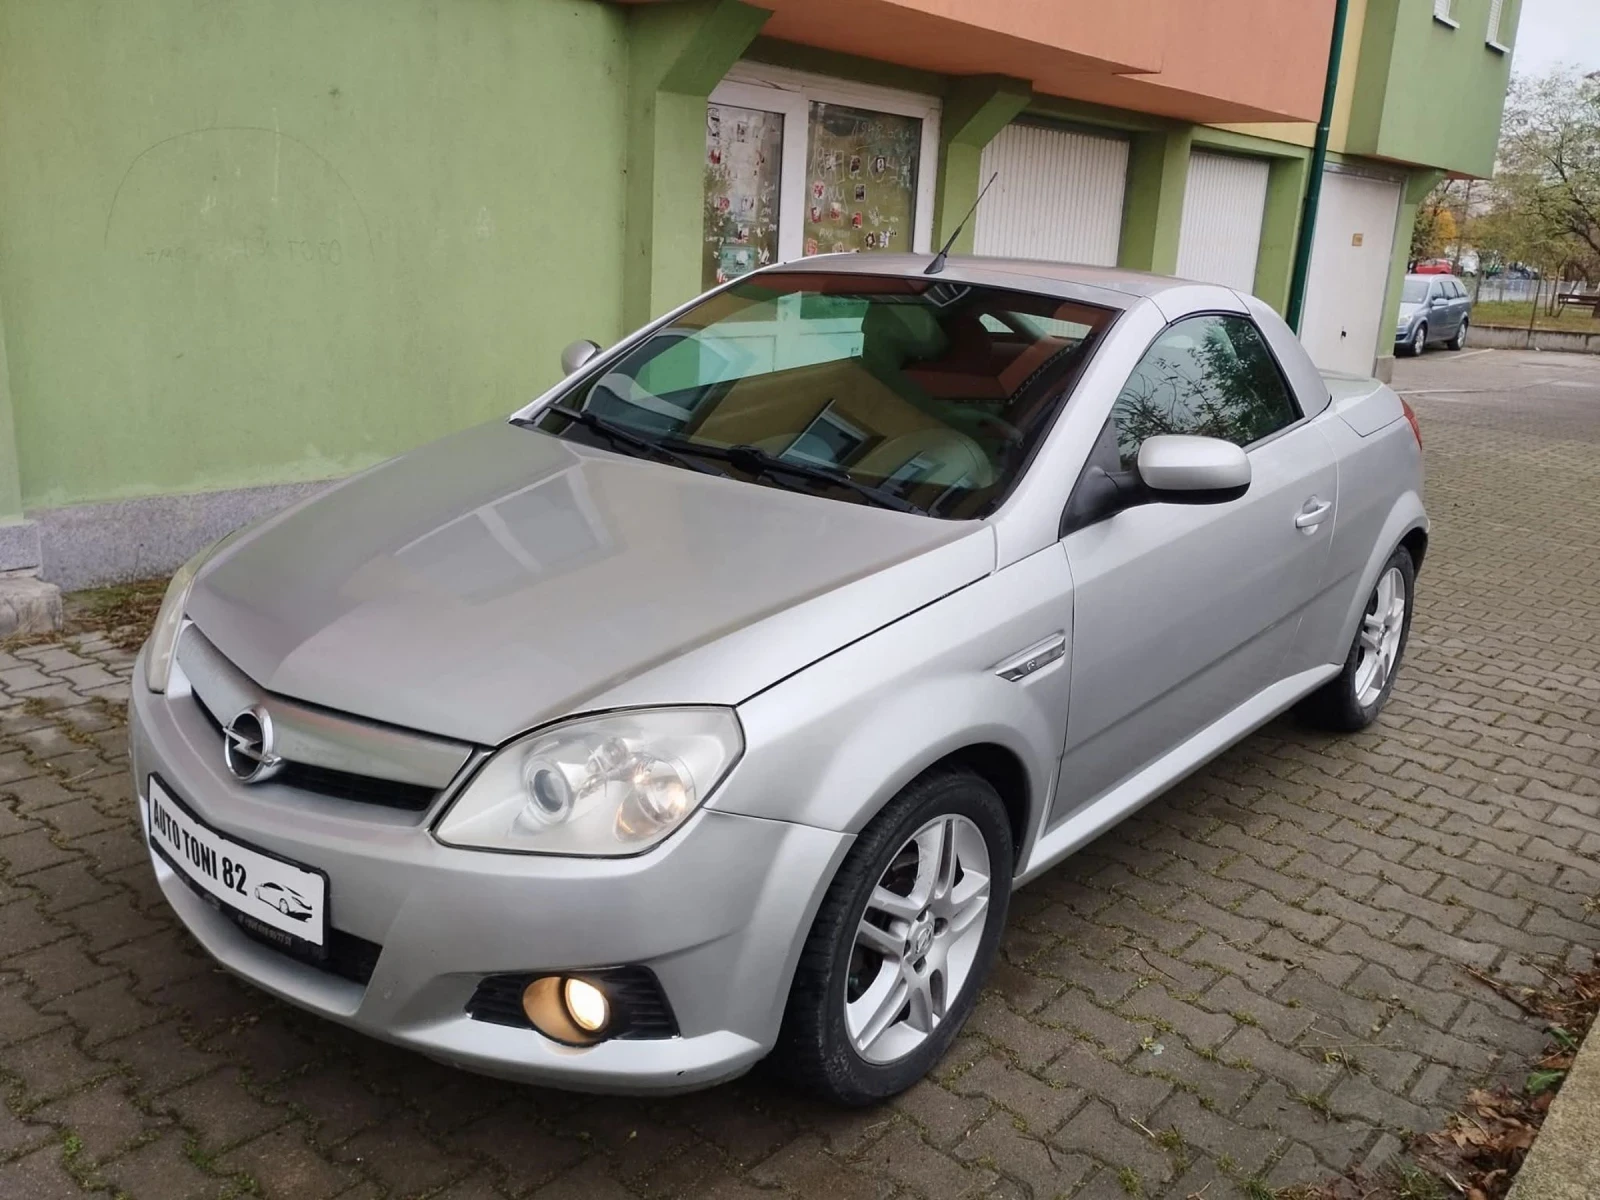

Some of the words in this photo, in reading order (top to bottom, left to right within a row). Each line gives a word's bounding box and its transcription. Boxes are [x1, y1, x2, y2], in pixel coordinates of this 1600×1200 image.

[153, 799, 181, 850] AUTO
[182, 829, 218, 880] TONI
[221, 856, 248, 897] 82
